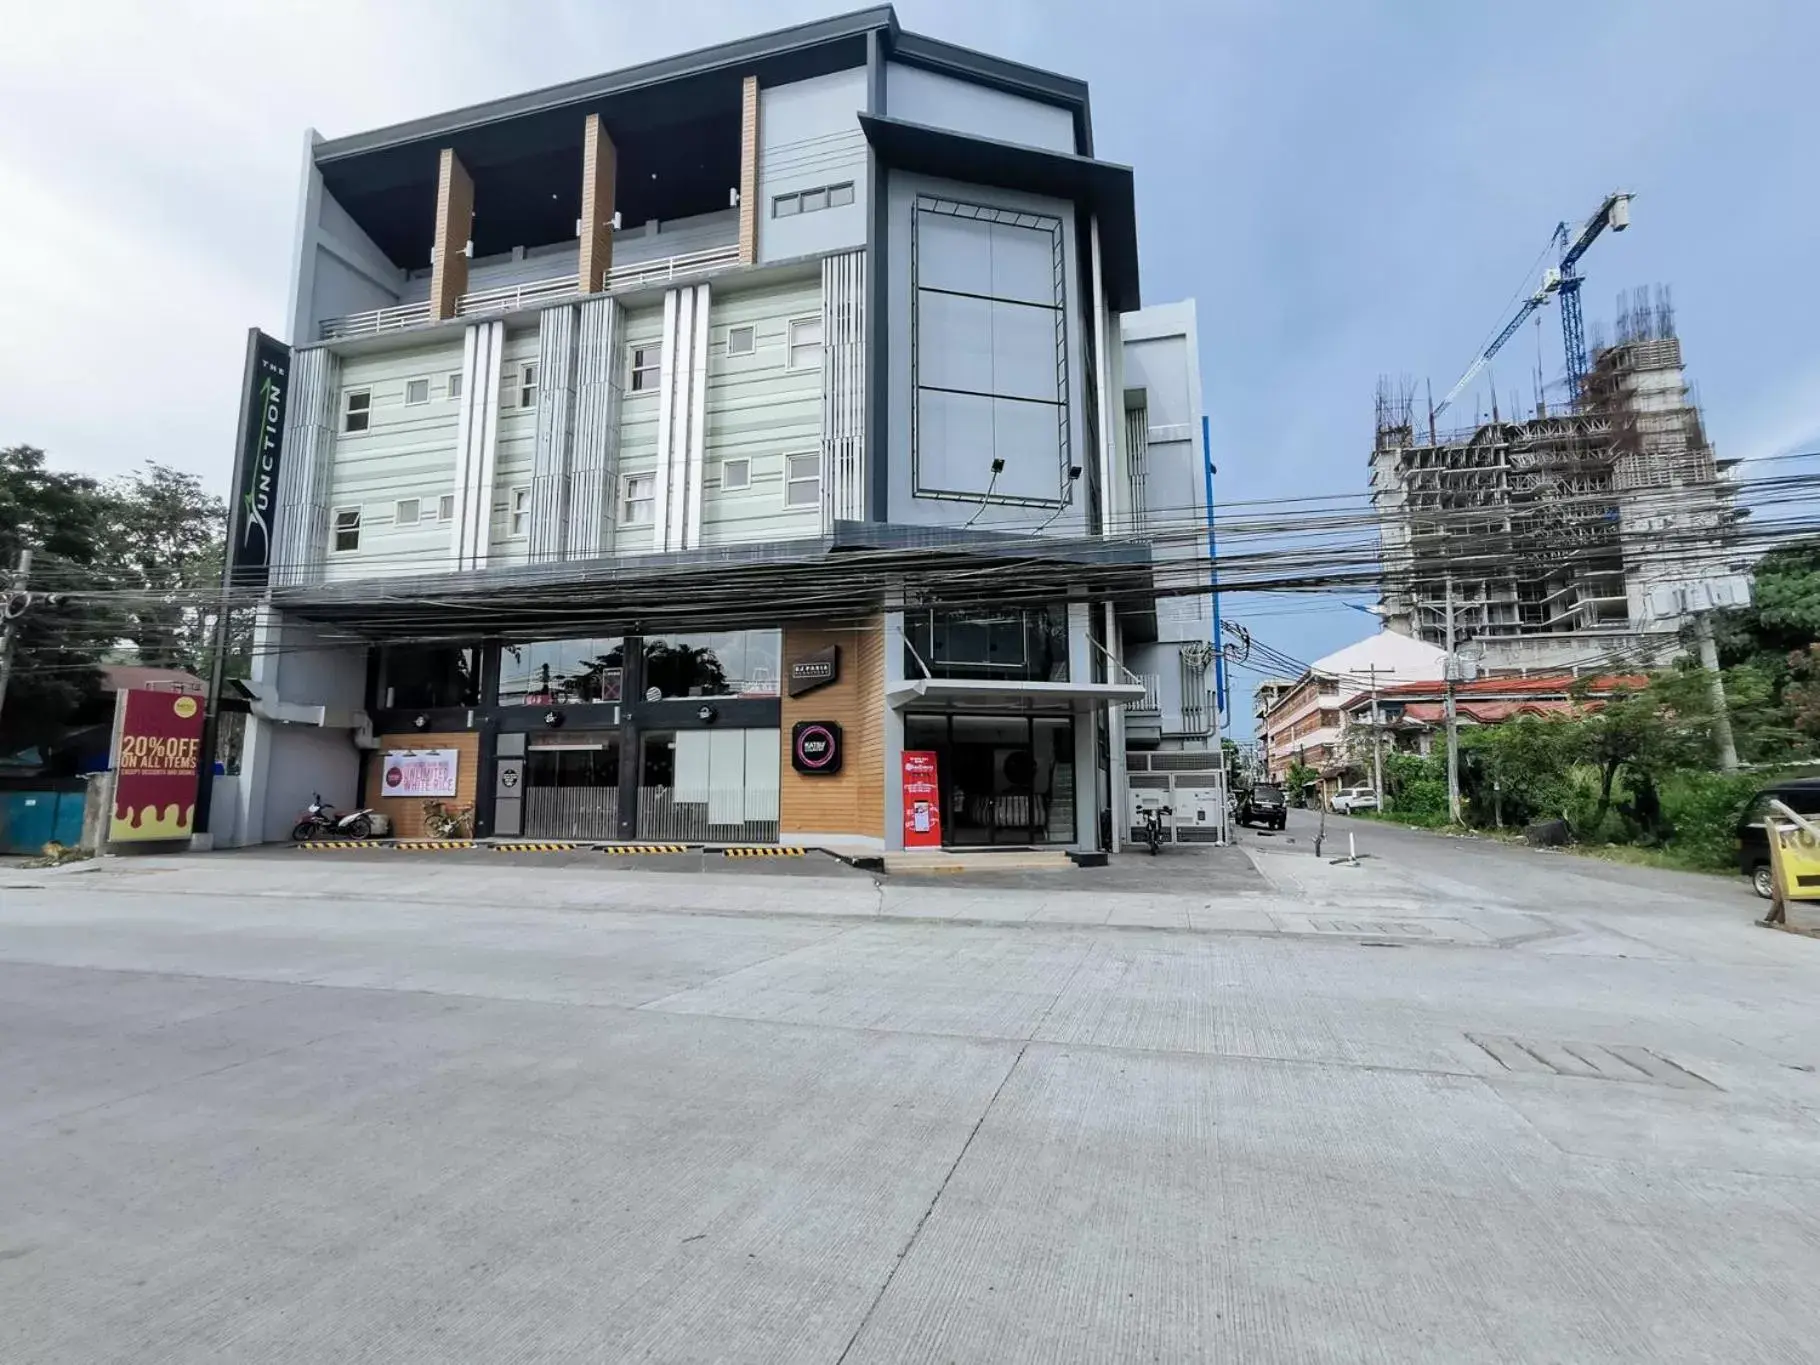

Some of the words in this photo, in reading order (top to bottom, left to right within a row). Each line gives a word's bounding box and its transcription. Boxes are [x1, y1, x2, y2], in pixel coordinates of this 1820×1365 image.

[262, 360, 285, 376] THE
[121, 754, 138, 768] ON
[140, 755, 161, 768] ALL
[164, 755, 197, 769] ITEMS
